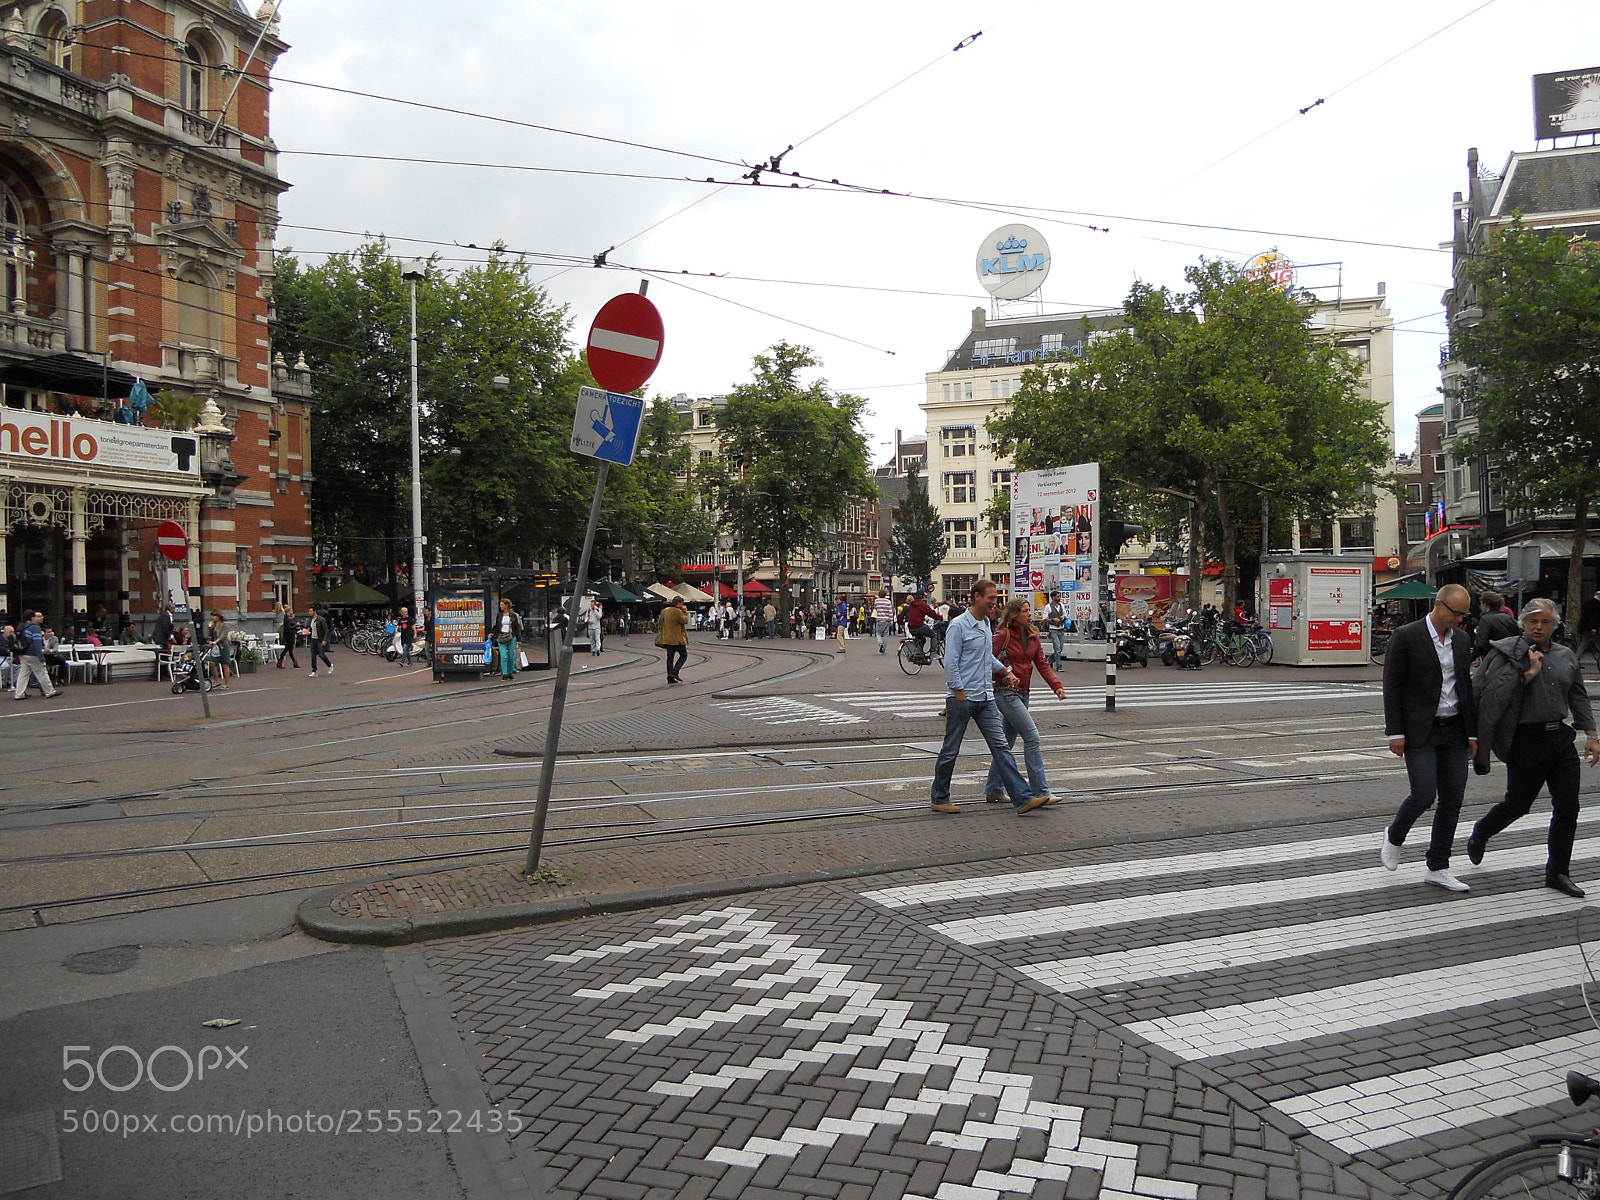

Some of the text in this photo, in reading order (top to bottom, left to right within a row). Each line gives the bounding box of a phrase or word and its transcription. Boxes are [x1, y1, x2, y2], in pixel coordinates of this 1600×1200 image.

[981, 253, 1044, 276] KLM
[1005, 340, 1082, 363] randstad
[580, 390, 642, 408] CAMERA TOEZICHT
[100, 436, 168, 450] toneelgroepamsterdam
[1043, 490, 1064, 498] september
[437, 600, 483, 611] COMPUTER
[453, 654, 485, 664] SATURN
